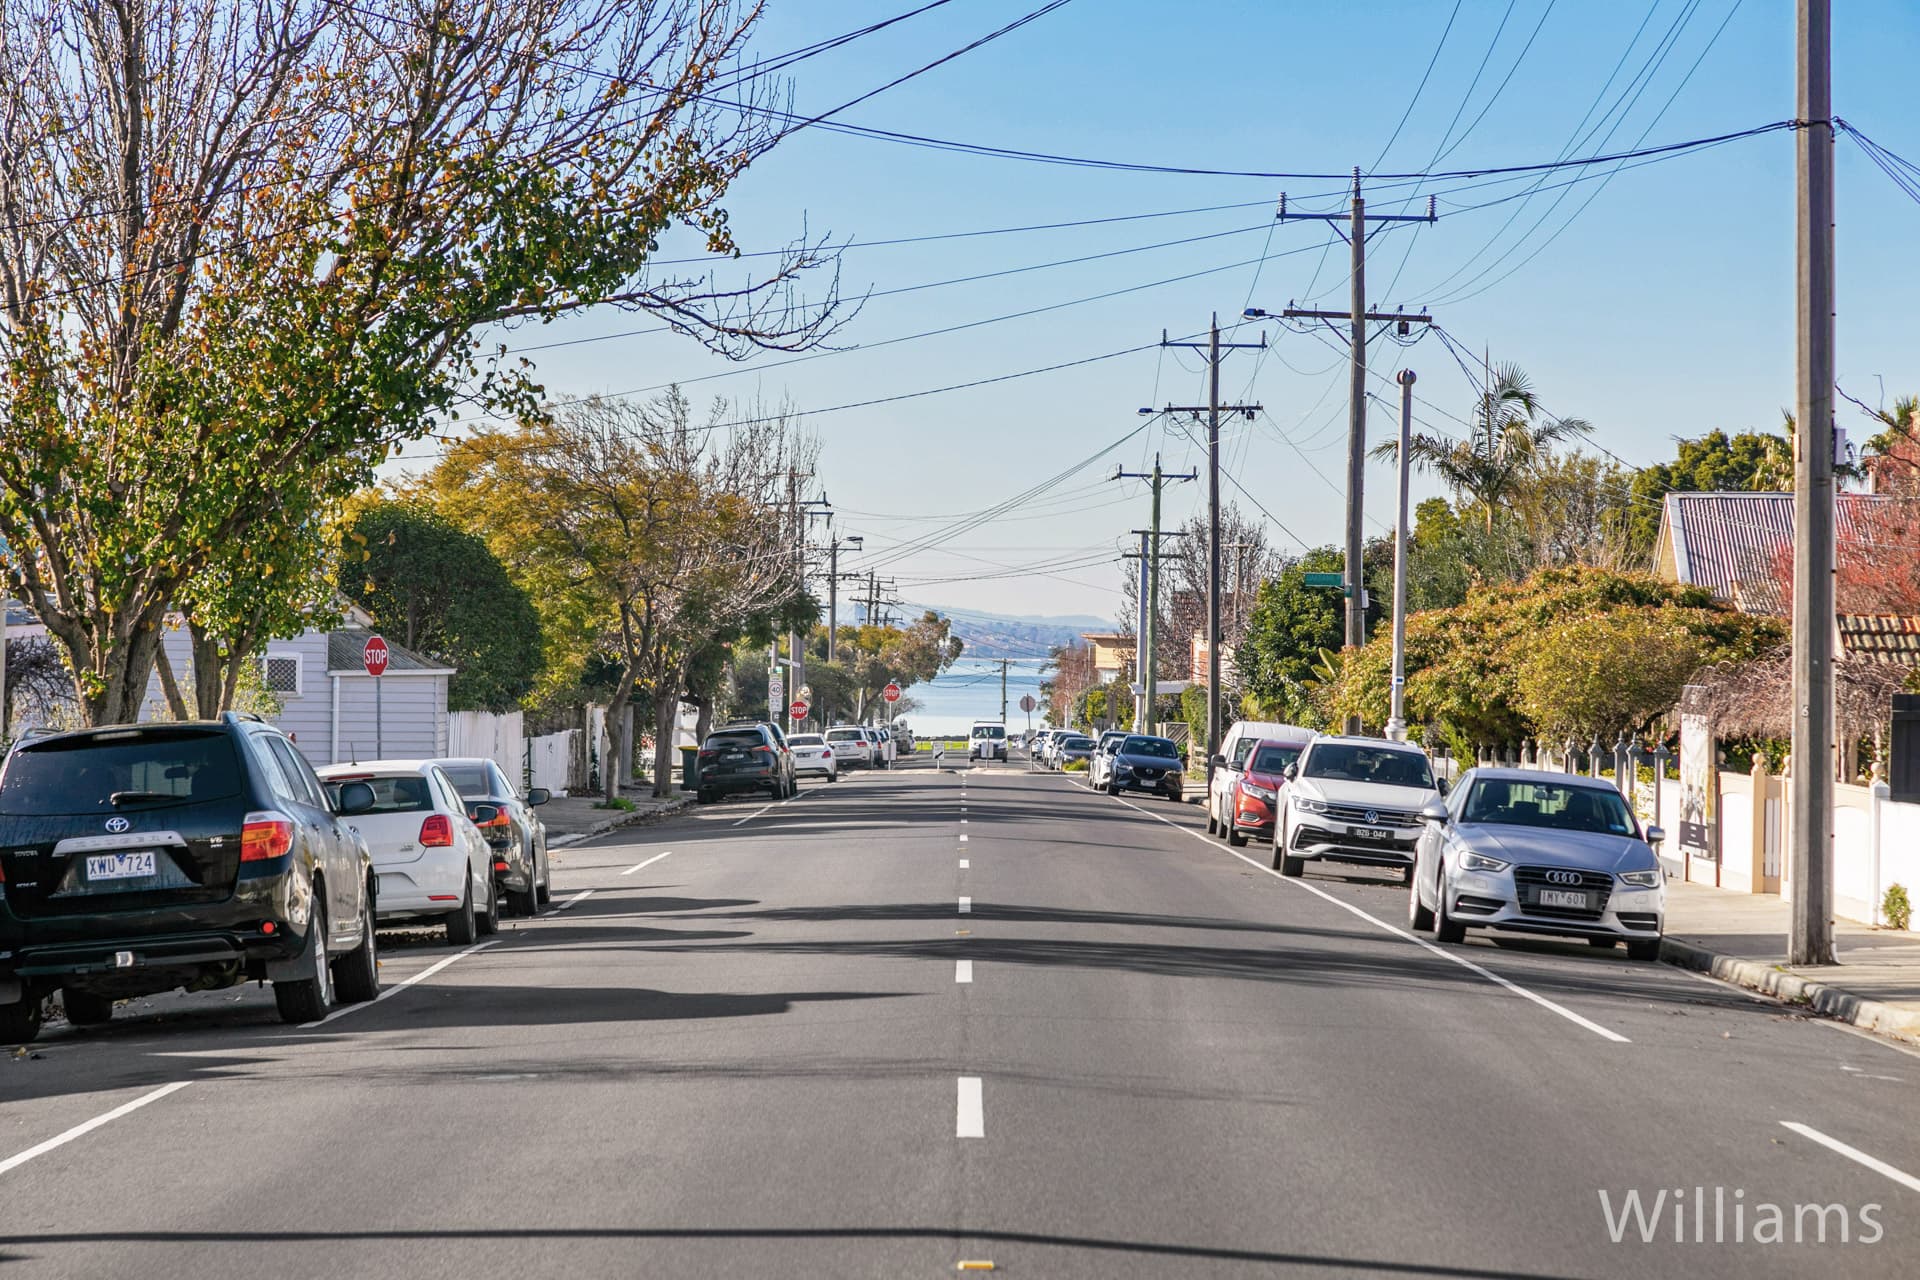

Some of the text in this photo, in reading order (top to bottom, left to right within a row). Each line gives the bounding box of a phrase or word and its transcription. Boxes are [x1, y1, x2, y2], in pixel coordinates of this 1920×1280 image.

[365, 649, 387, 664] STOP
[884, 689, 900, 697] STOP
[790, 706, 807, 714] STOP
[89, 857, 115, 875] XWU
[126, 855, 152, 871] 724
